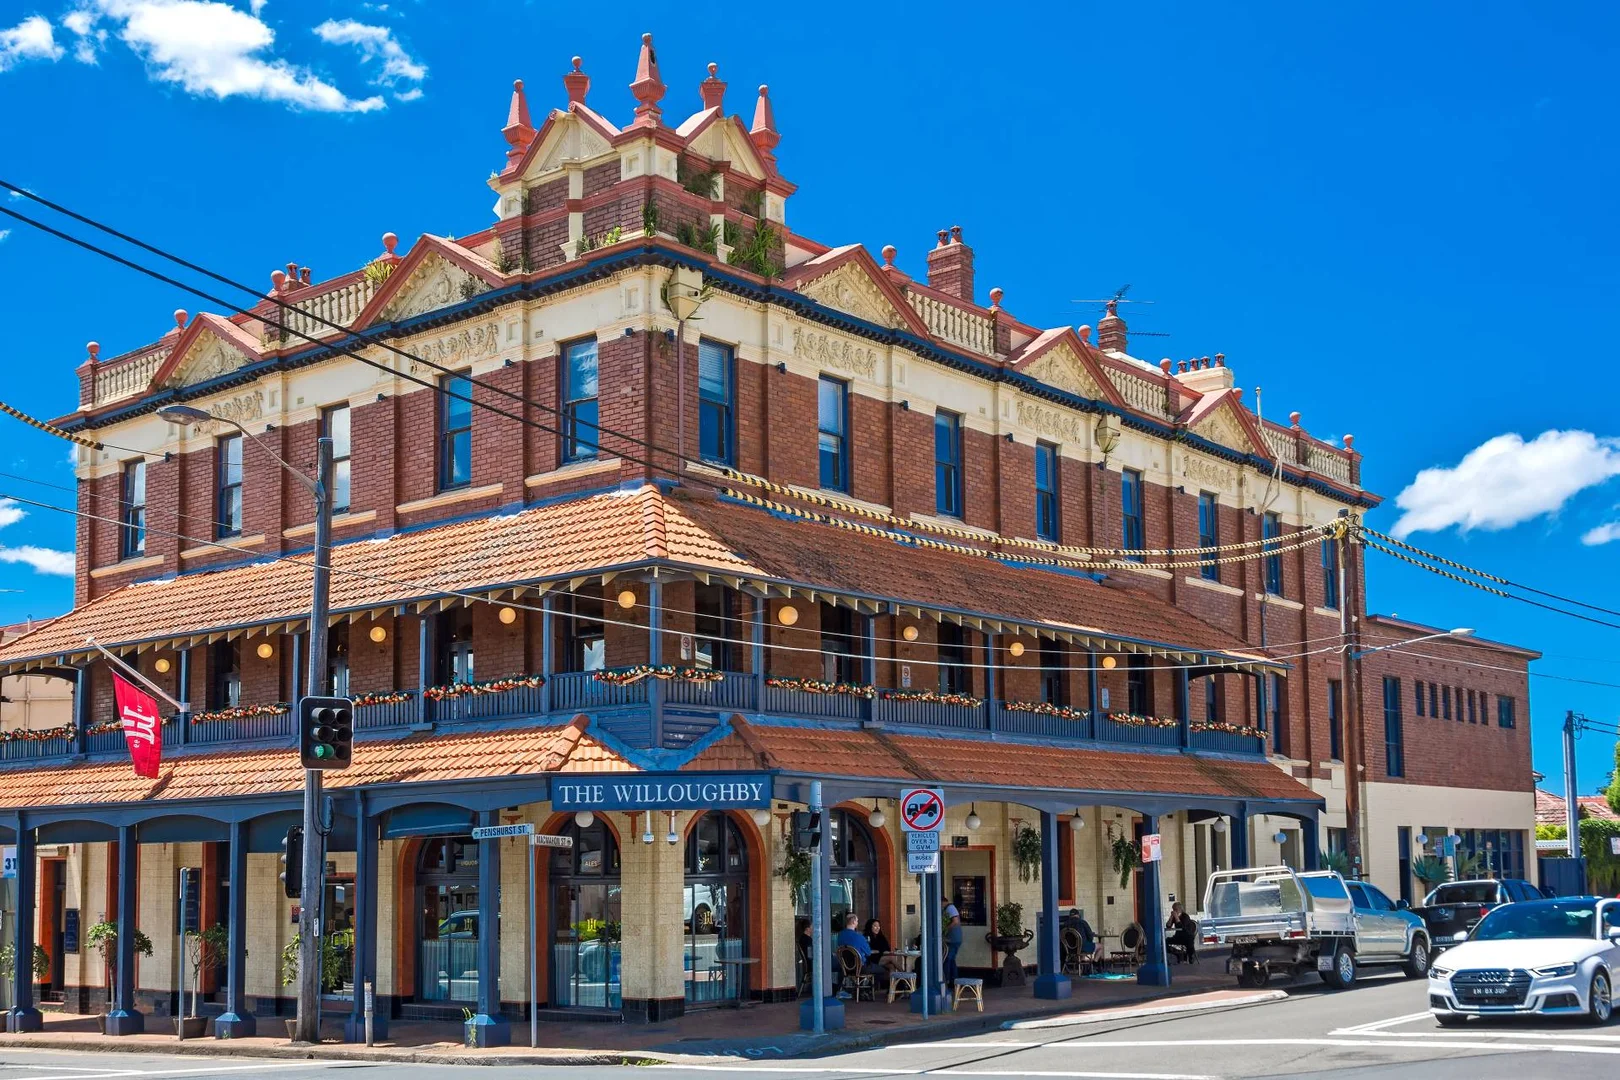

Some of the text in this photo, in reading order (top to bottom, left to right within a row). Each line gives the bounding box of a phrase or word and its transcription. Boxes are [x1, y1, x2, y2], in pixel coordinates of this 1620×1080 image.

[559, 783, 764, 804] THE WILLOUGHBY
[480, 824, 526, 837] PENSHURST ST
